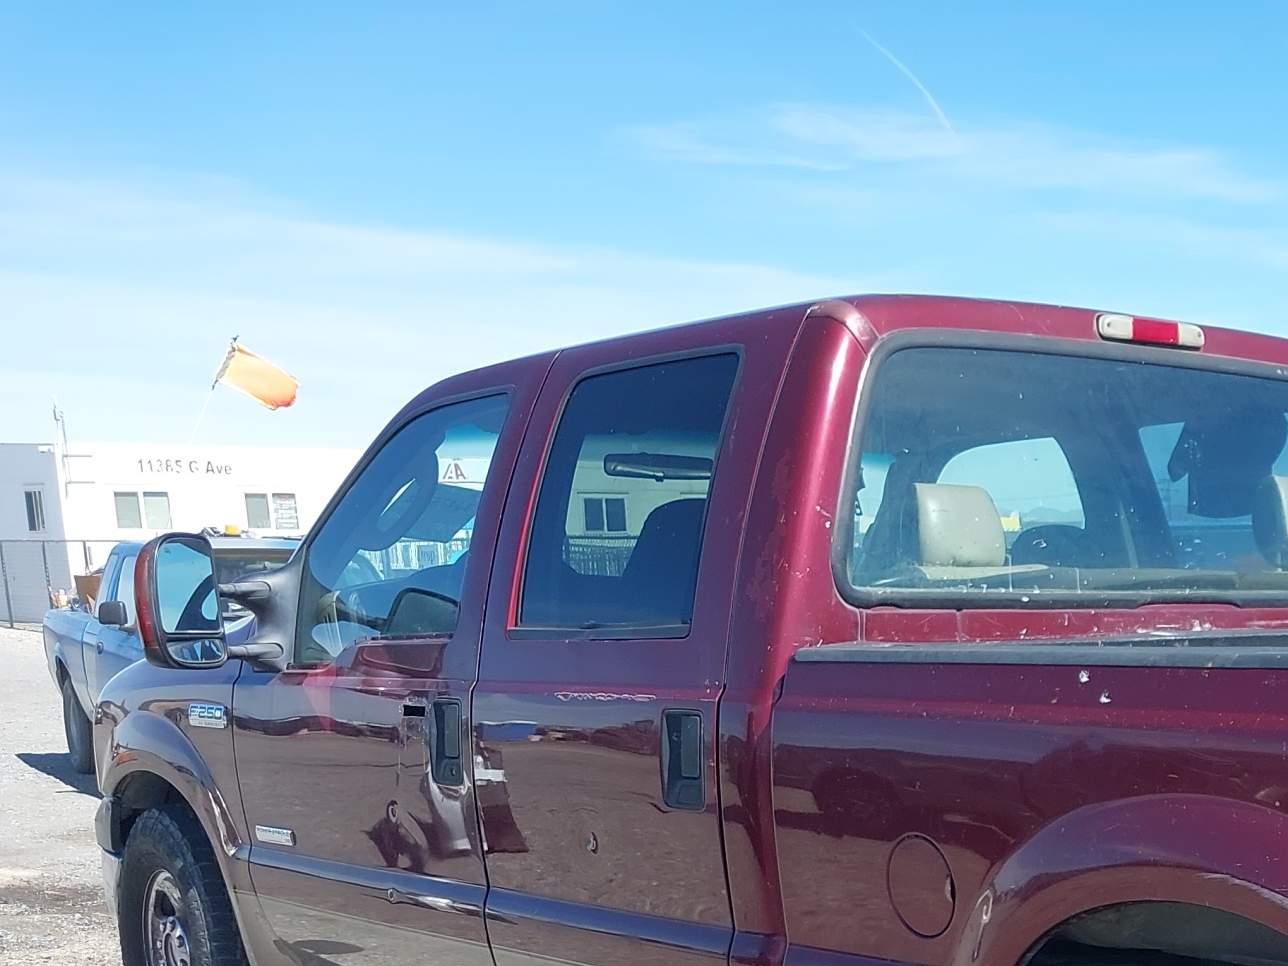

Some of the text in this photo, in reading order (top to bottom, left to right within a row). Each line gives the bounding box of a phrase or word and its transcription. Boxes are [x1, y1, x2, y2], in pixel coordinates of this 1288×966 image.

[137, 458, 233, 475] 11385 G Ave
